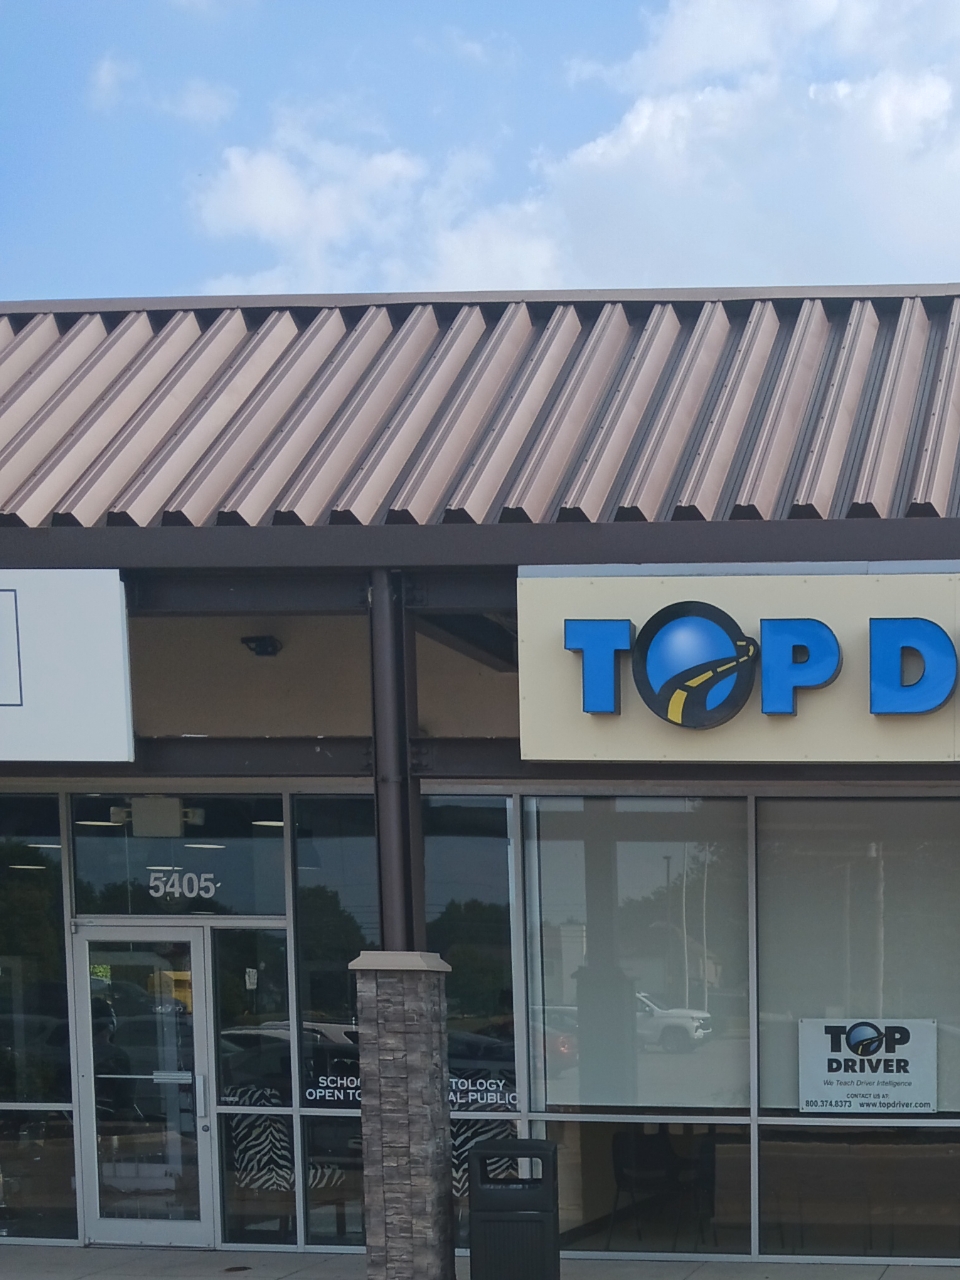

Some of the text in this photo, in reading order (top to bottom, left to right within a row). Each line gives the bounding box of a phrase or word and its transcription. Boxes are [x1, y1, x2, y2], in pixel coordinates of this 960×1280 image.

[564, 599, 843, 729] TOP
[148, 871, 216, 899] 5405
[824, 1021, 911, 1056] TOP
[827, 1058, 910, 1074] DRIVER
[318, 1075, 361, 1088] SCHO
[447, 1078, 506, 1091] TOLOGY
[836, 1079, 855, 1087] Teach
[856, 1079, 876, 1087] Driver
[876, 1079, 913, 1088] Intelligence
[305, 1088, 344, 1100] OPEN
[448, 1091, 519, 1104] AL PUBLIC
[805, 1099, 931, 1109] 800.374.8373 www.topdriver.com
